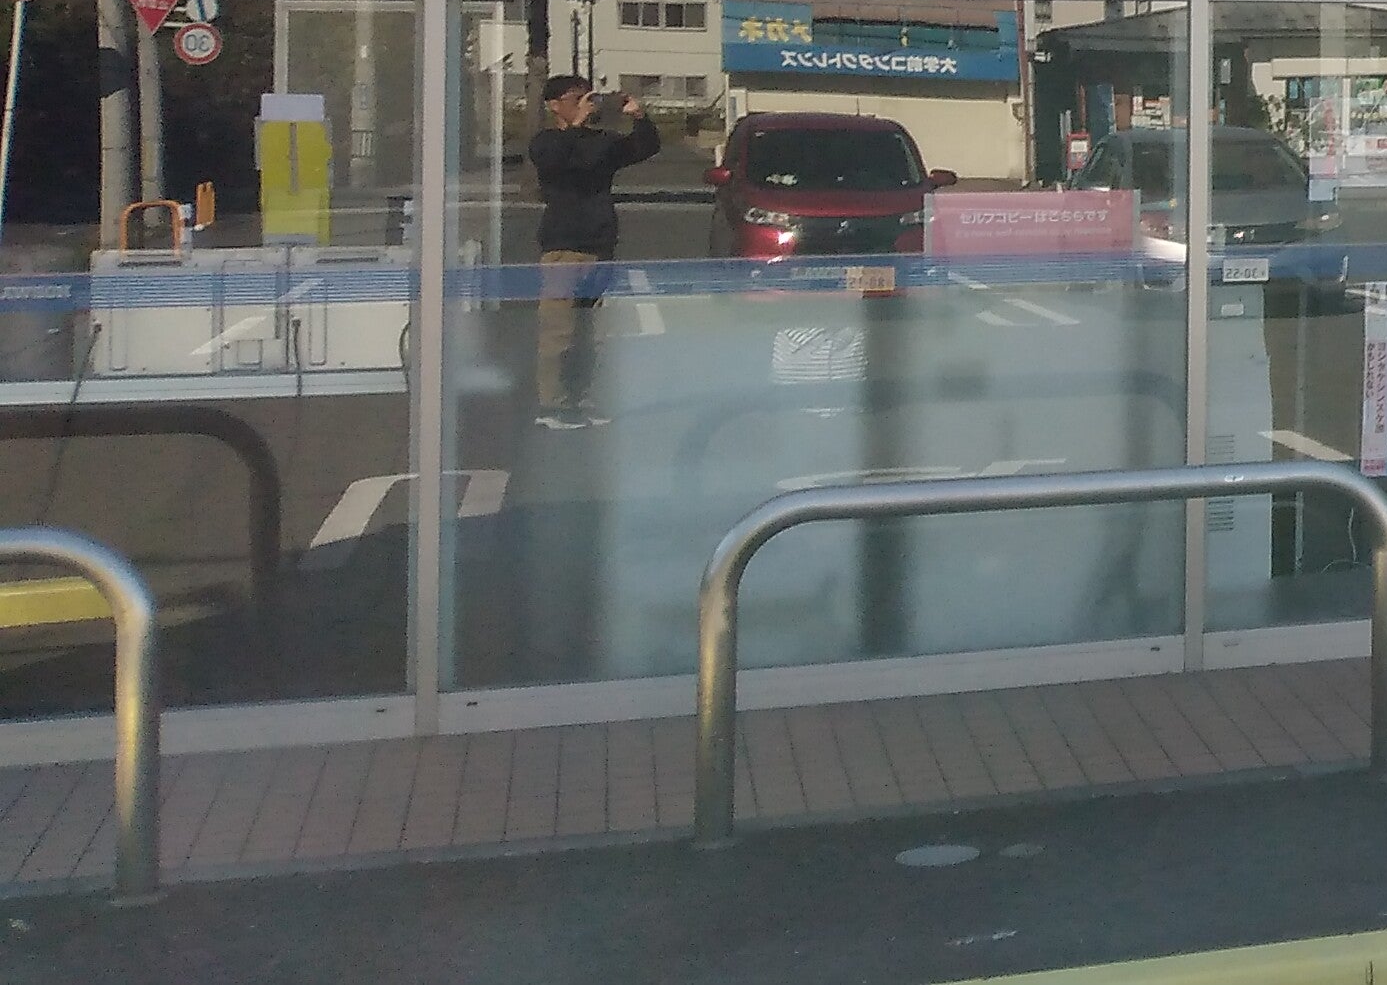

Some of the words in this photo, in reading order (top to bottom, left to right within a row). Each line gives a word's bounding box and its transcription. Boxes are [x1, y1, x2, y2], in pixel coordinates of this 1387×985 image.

[960, 209, 1109, 224] セルフコピーはこちらです
